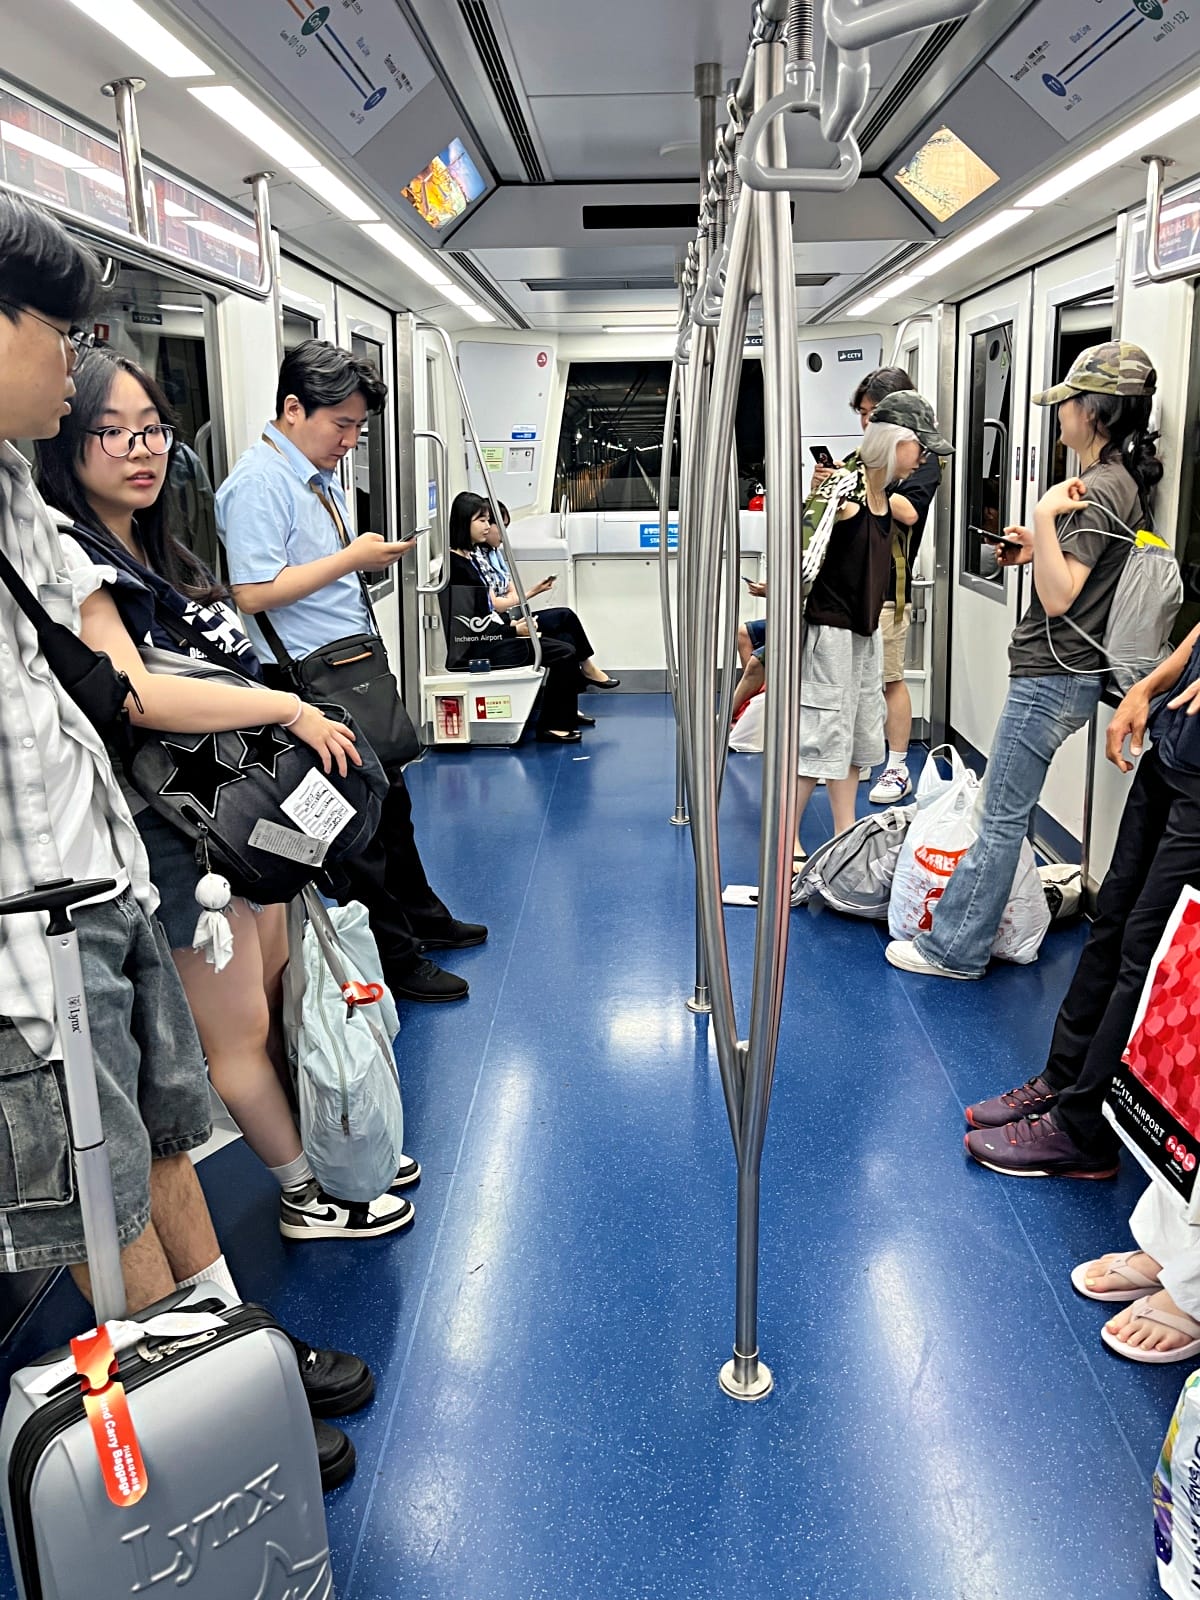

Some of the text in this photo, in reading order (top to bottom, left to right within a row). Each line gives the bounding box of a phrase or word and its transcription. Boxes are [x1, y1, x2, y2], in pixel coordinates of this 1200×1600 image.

[308, 12, 323, 30] Con
[1160, 10, 1190, 34] 101-132
[454, 634, 503, 643] Incheon Airport
[68, 1009, 80, 1033] Lynx
[1133, 1103, 1165, 1138] AIRPORT
[104, 1419, 120, 1449] Carry
[112, 1448, 131, 1497] Baggage
[120, 1462, 286, 1593] Lynx
